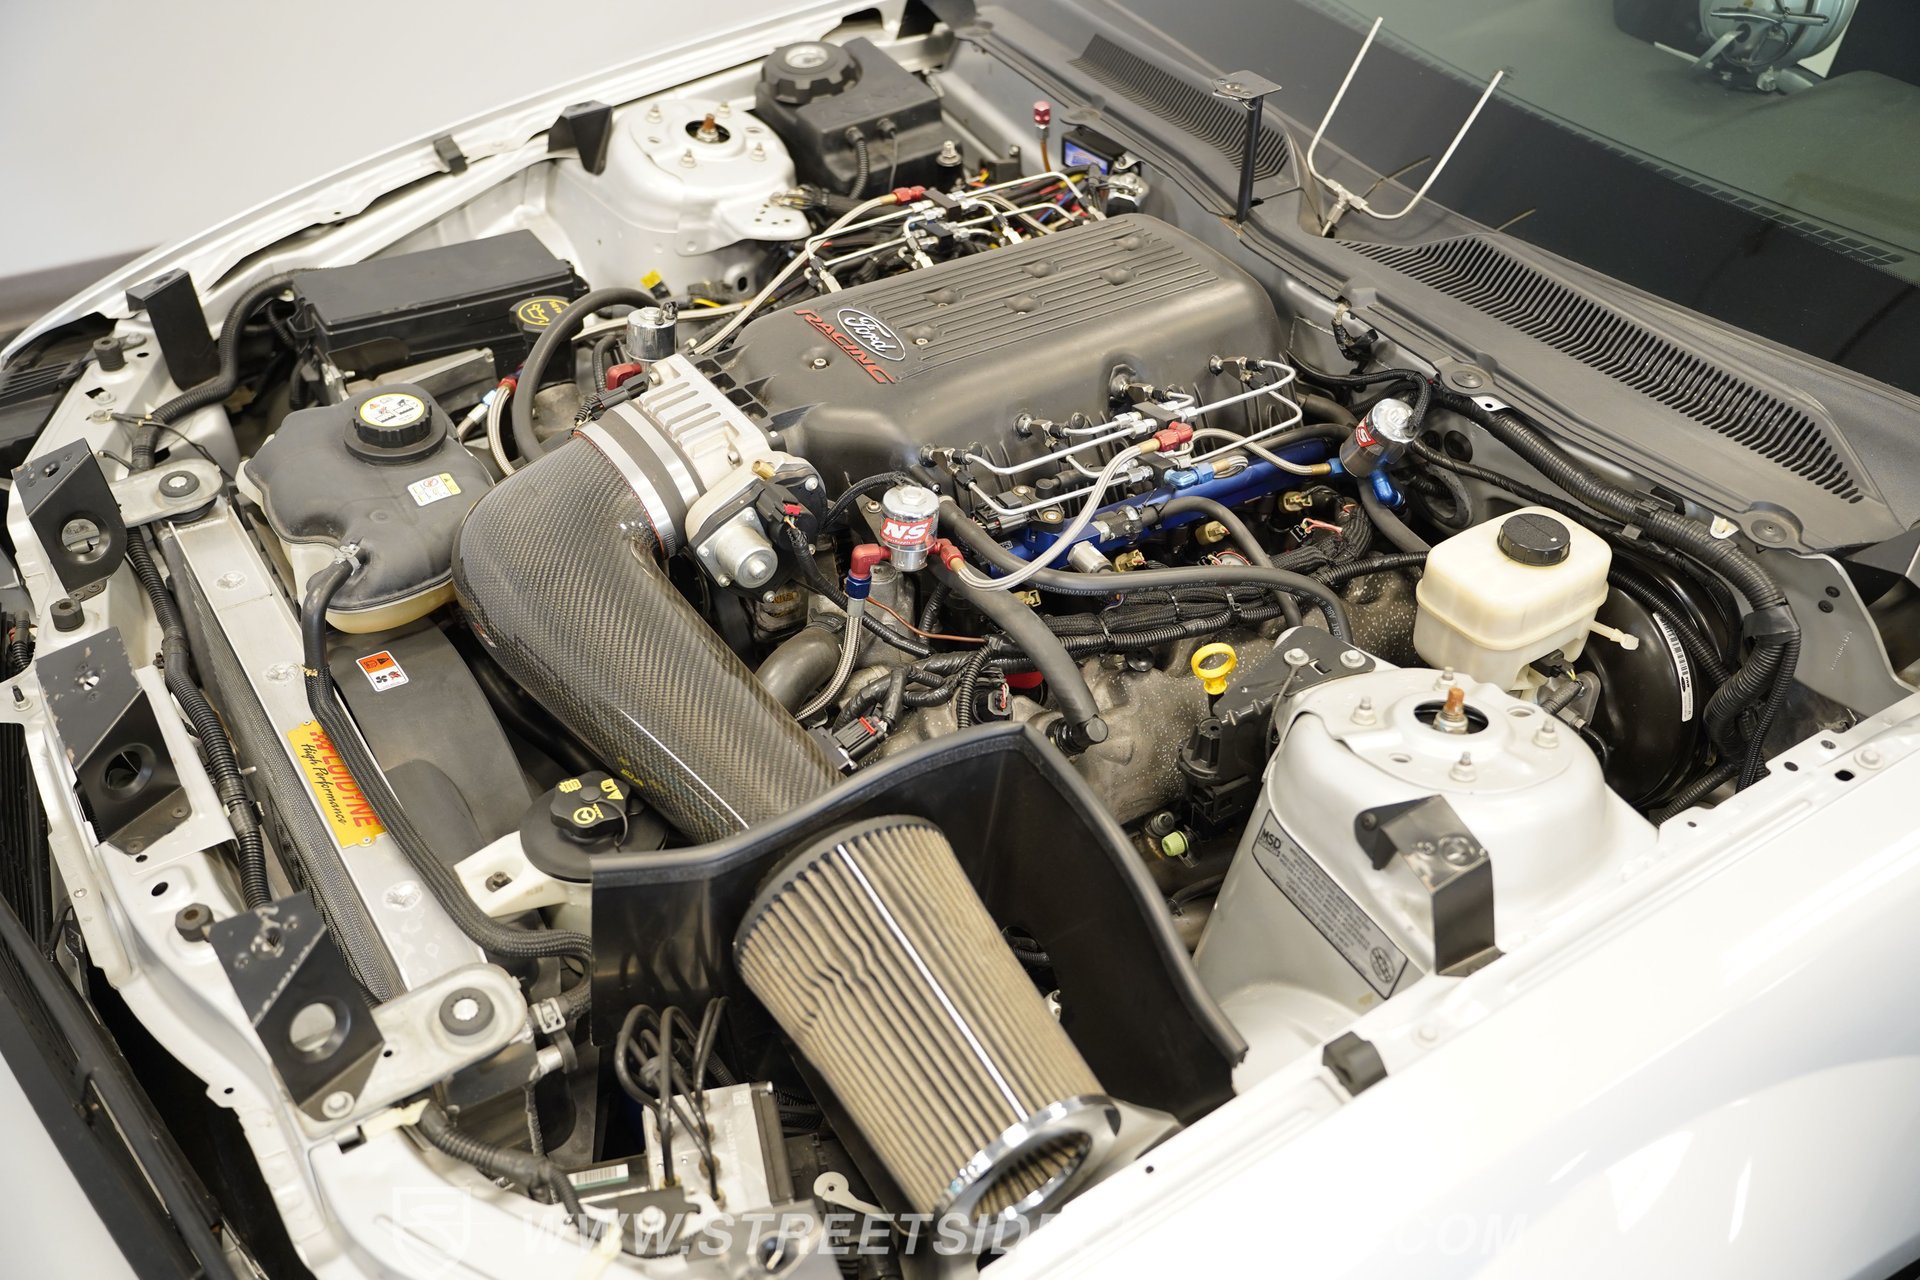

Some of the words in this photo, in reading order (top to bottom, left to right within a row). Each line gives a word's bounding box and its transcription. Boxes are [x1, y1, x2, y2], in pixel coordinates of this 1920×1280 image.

[794, 309, 896, 384] RACING
[844, 317, 897, 352] Ford
[883, 521, 929, 540] NS
[301, 743, 322, 767] High
[312, 766, 347, 825] Performance
[1260, 828, 1281, 850] MSD
